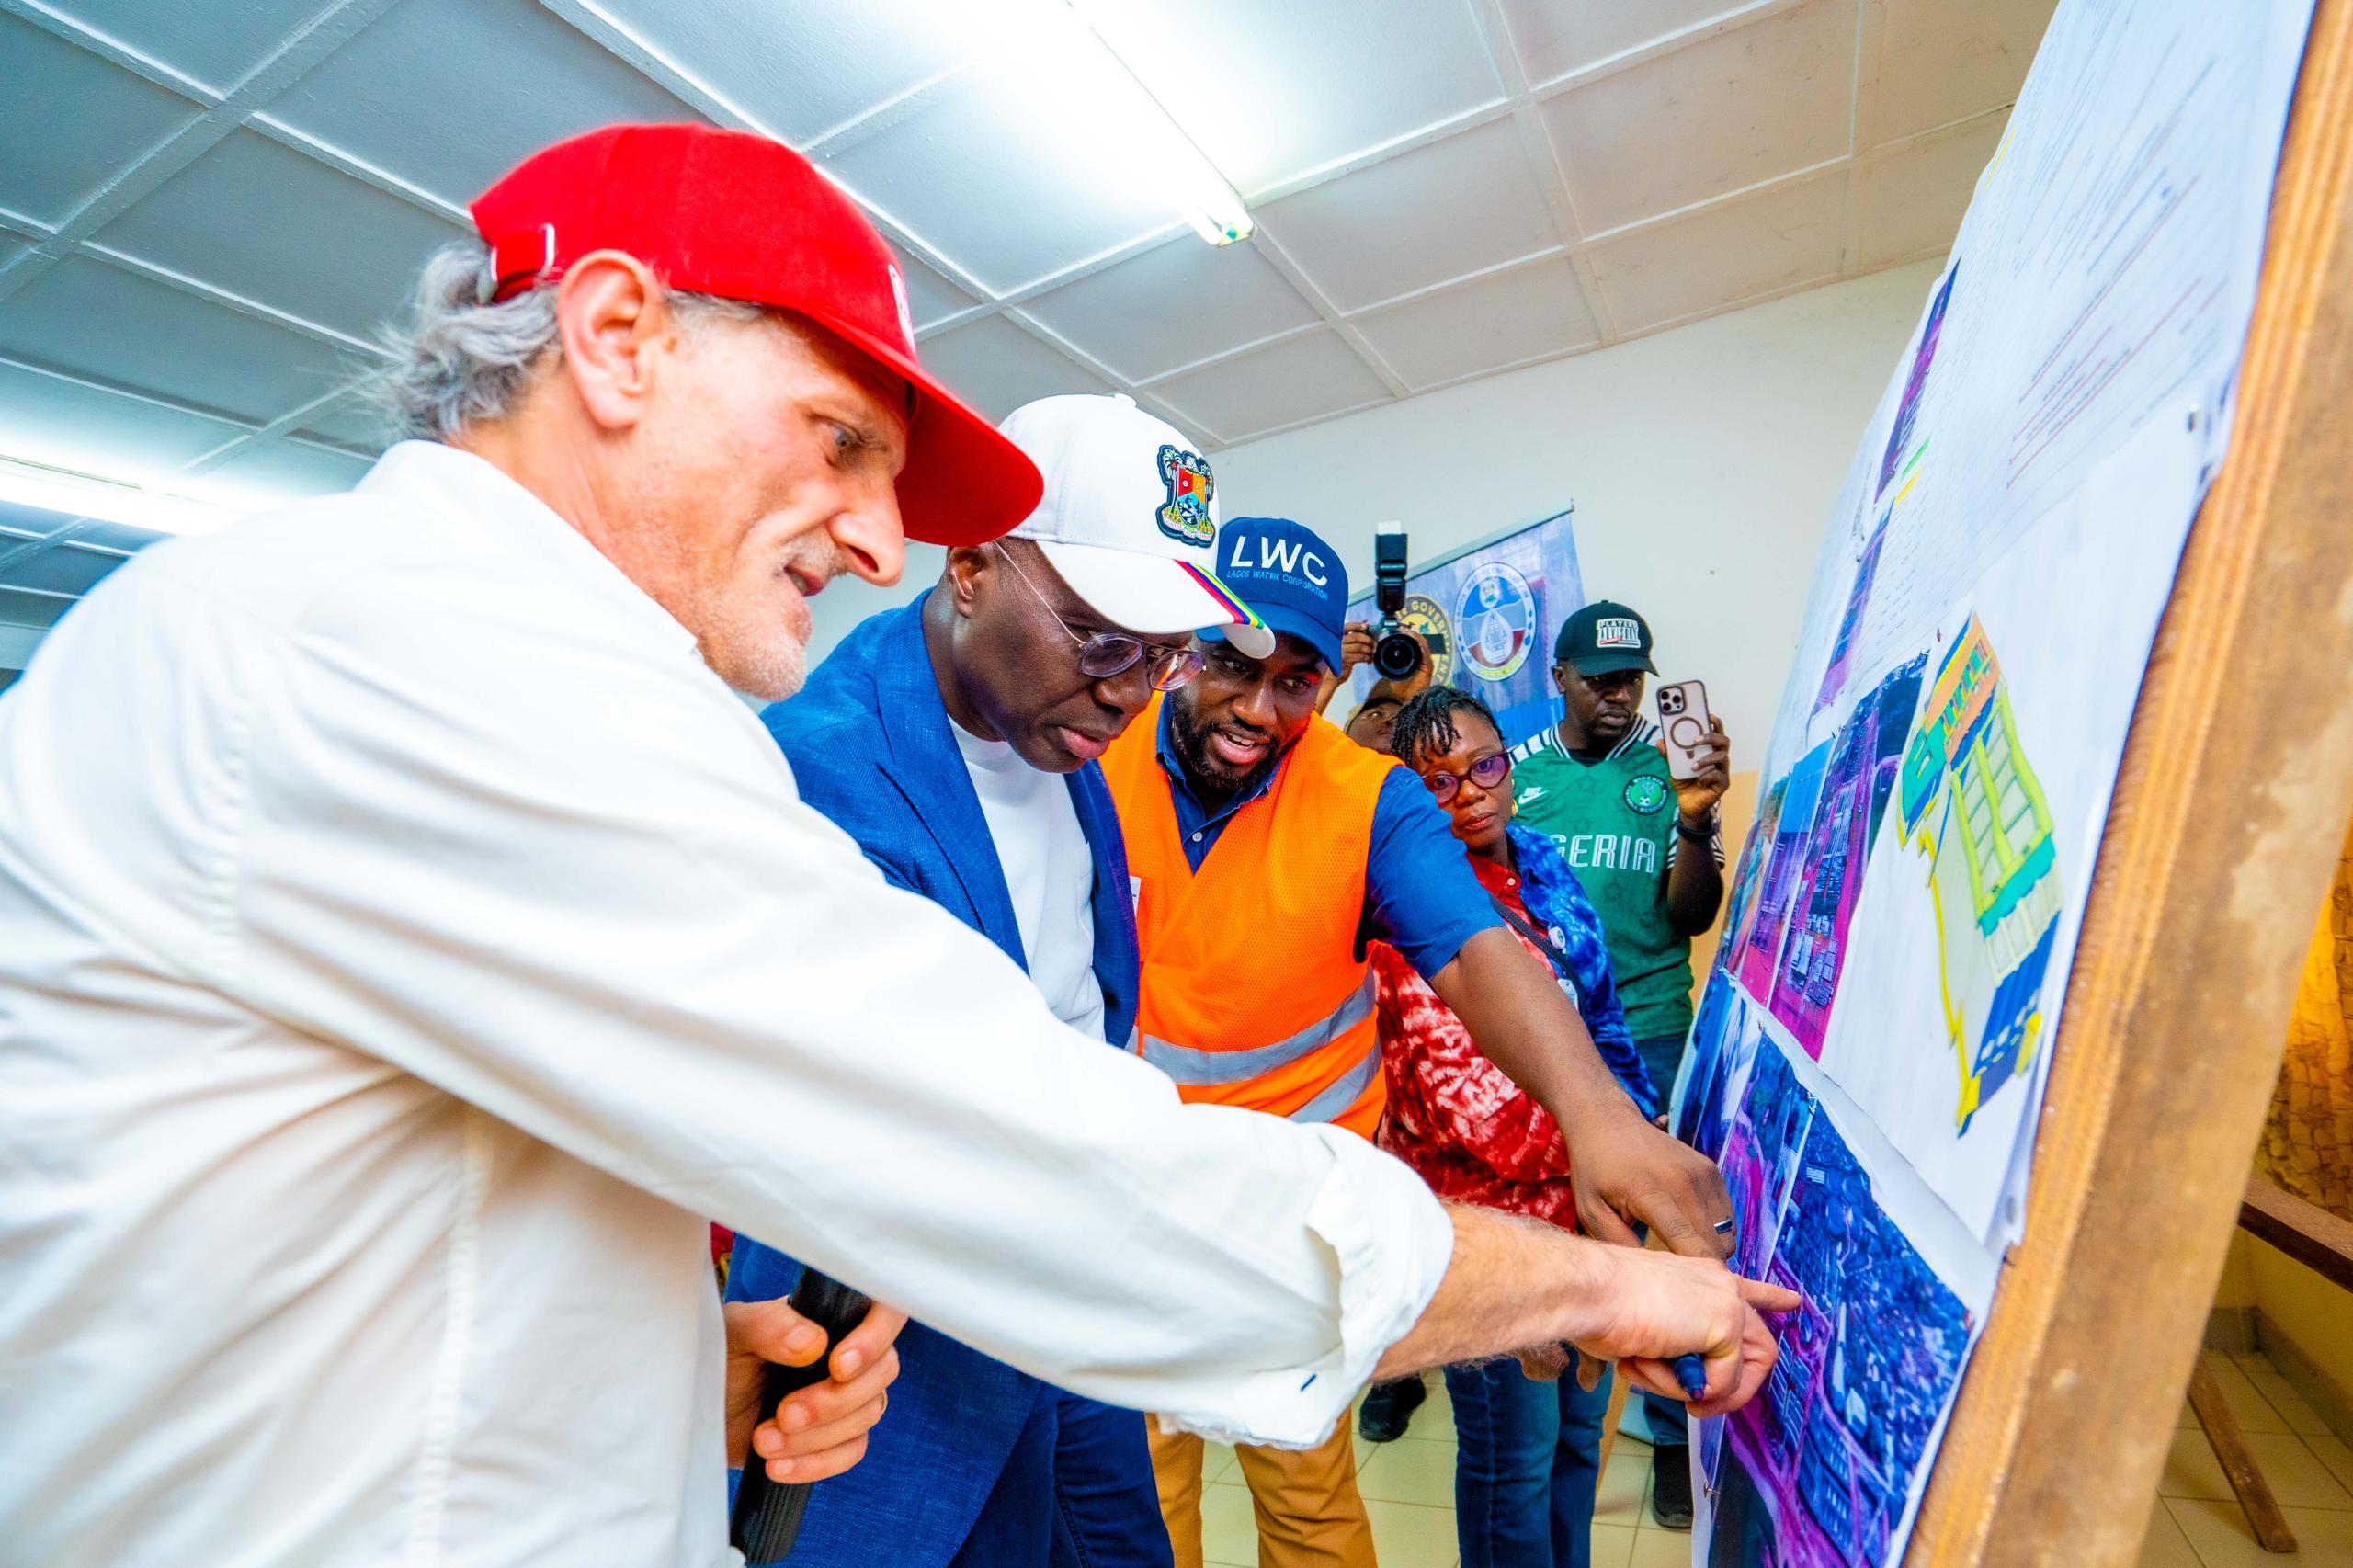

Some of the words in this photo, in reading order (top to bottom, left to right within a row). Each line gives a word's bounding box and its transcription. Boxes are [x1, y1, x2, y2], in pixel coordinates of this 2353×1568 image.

[1230, 535, 1328, 586] LWC
[1227, 570, 1250, 579] LAGOS
[1253, 570, 1279, 581] WATER
[1282, 574, 1329, 601] CORPORATION
